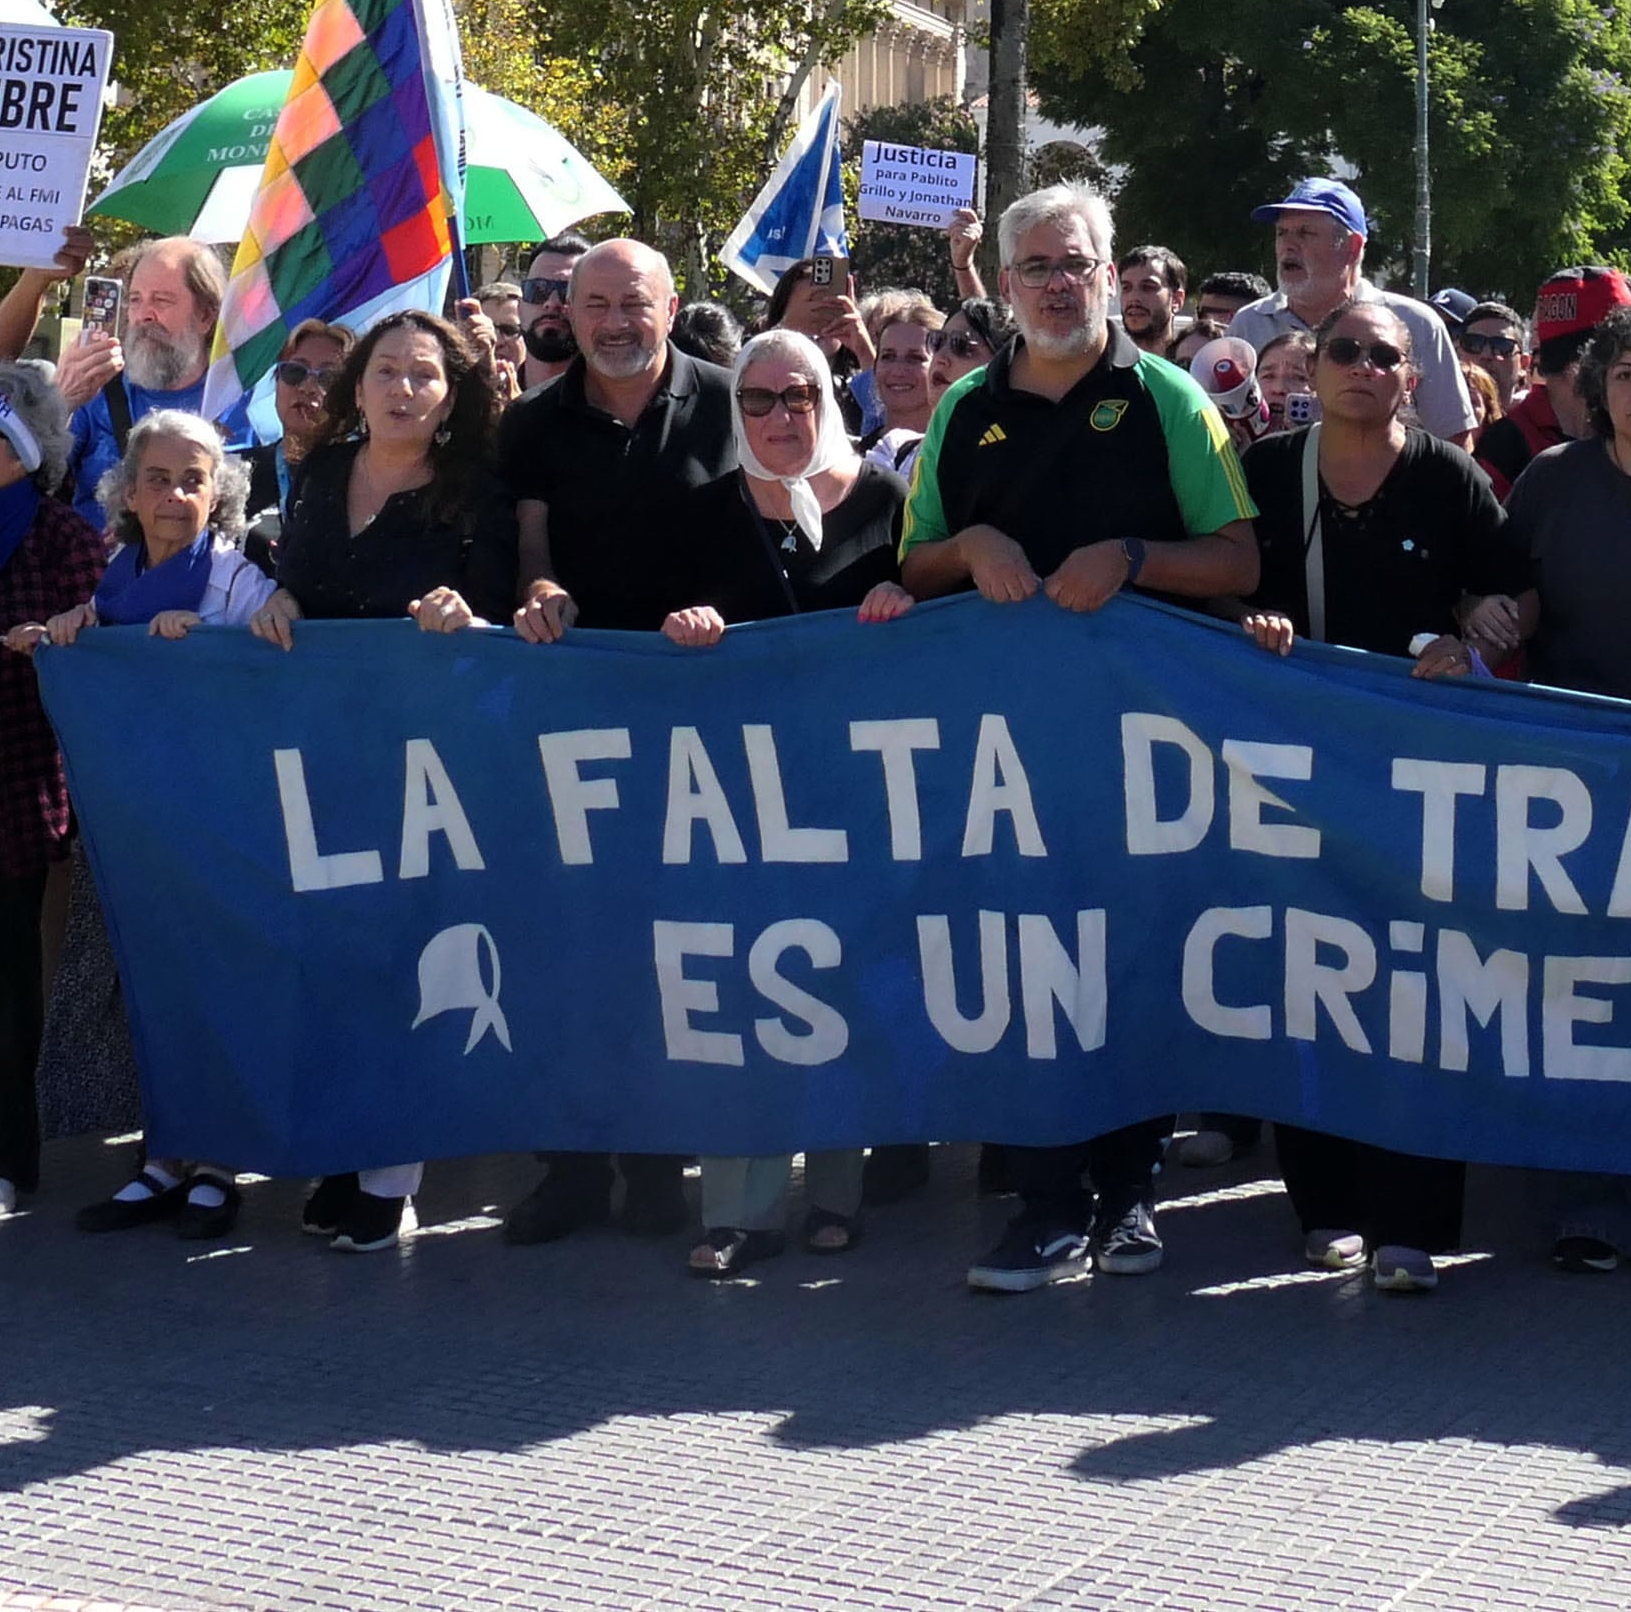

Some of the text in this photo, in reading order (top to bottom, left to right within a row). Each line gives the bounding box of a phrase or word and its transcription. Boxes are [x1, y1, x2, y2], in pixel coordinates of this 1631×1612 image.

[872, 143, 958, 170] Justicia
[876, 169, 959, 188] para Pablito
[5, 186, 25, 201] AL
[29, 188, 61, 205] FMI
[859, 183, 972, 208] Grillo y Jonathan
[0, 215, 54, 234] PAGAS
[885, 205, 942, 223] Navarro
[275, 740, 484, 891] LA
[539, 713, 1046, 864] FALTA
[1122, 713, 1320, 858] DE
[654, 921, 848, 1066] ES
[917, 909, 1106, 1059] UN
